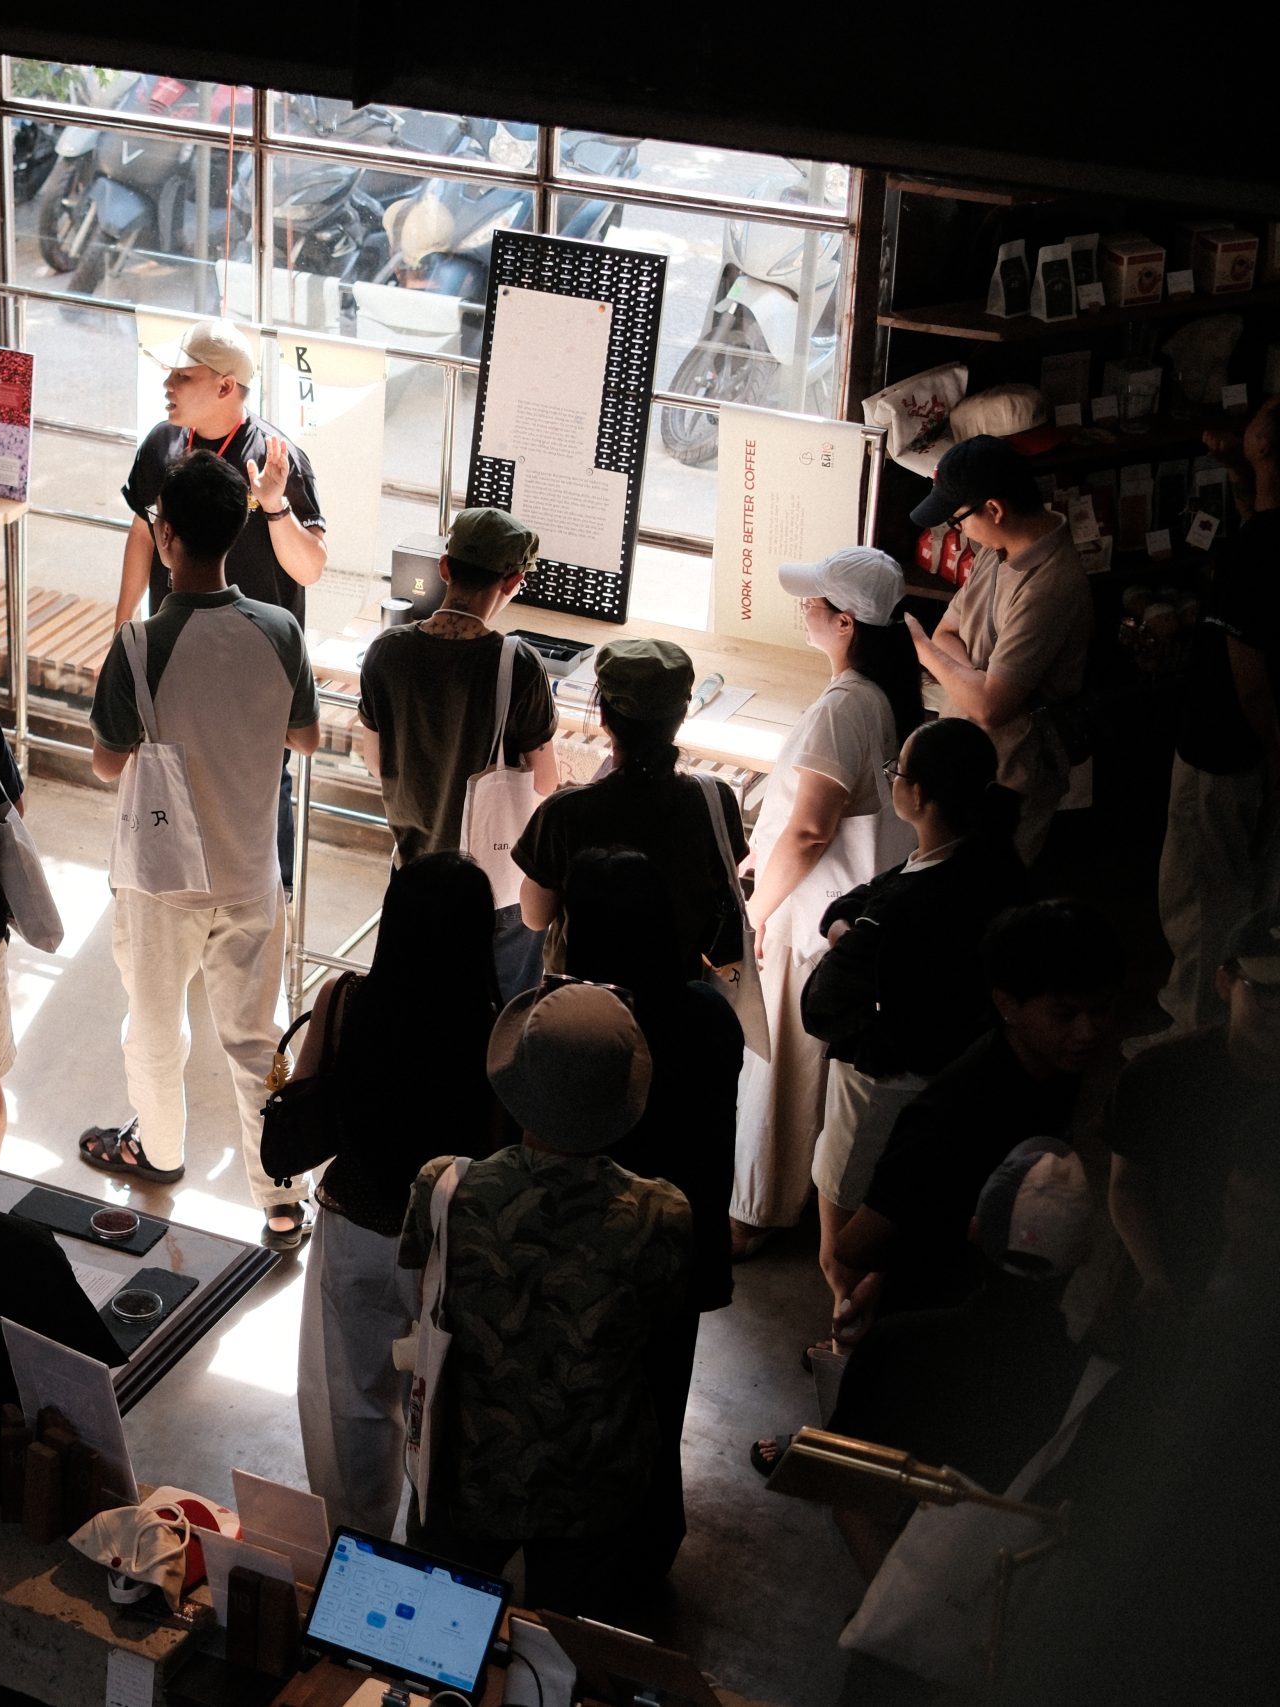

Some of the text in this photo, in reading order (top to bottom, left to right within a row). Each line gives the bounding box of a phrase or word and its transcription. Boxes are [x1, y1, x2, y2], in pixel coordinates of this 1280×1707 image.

[741, 439, 756, 620] WORK FOR BETTER COFFEE
